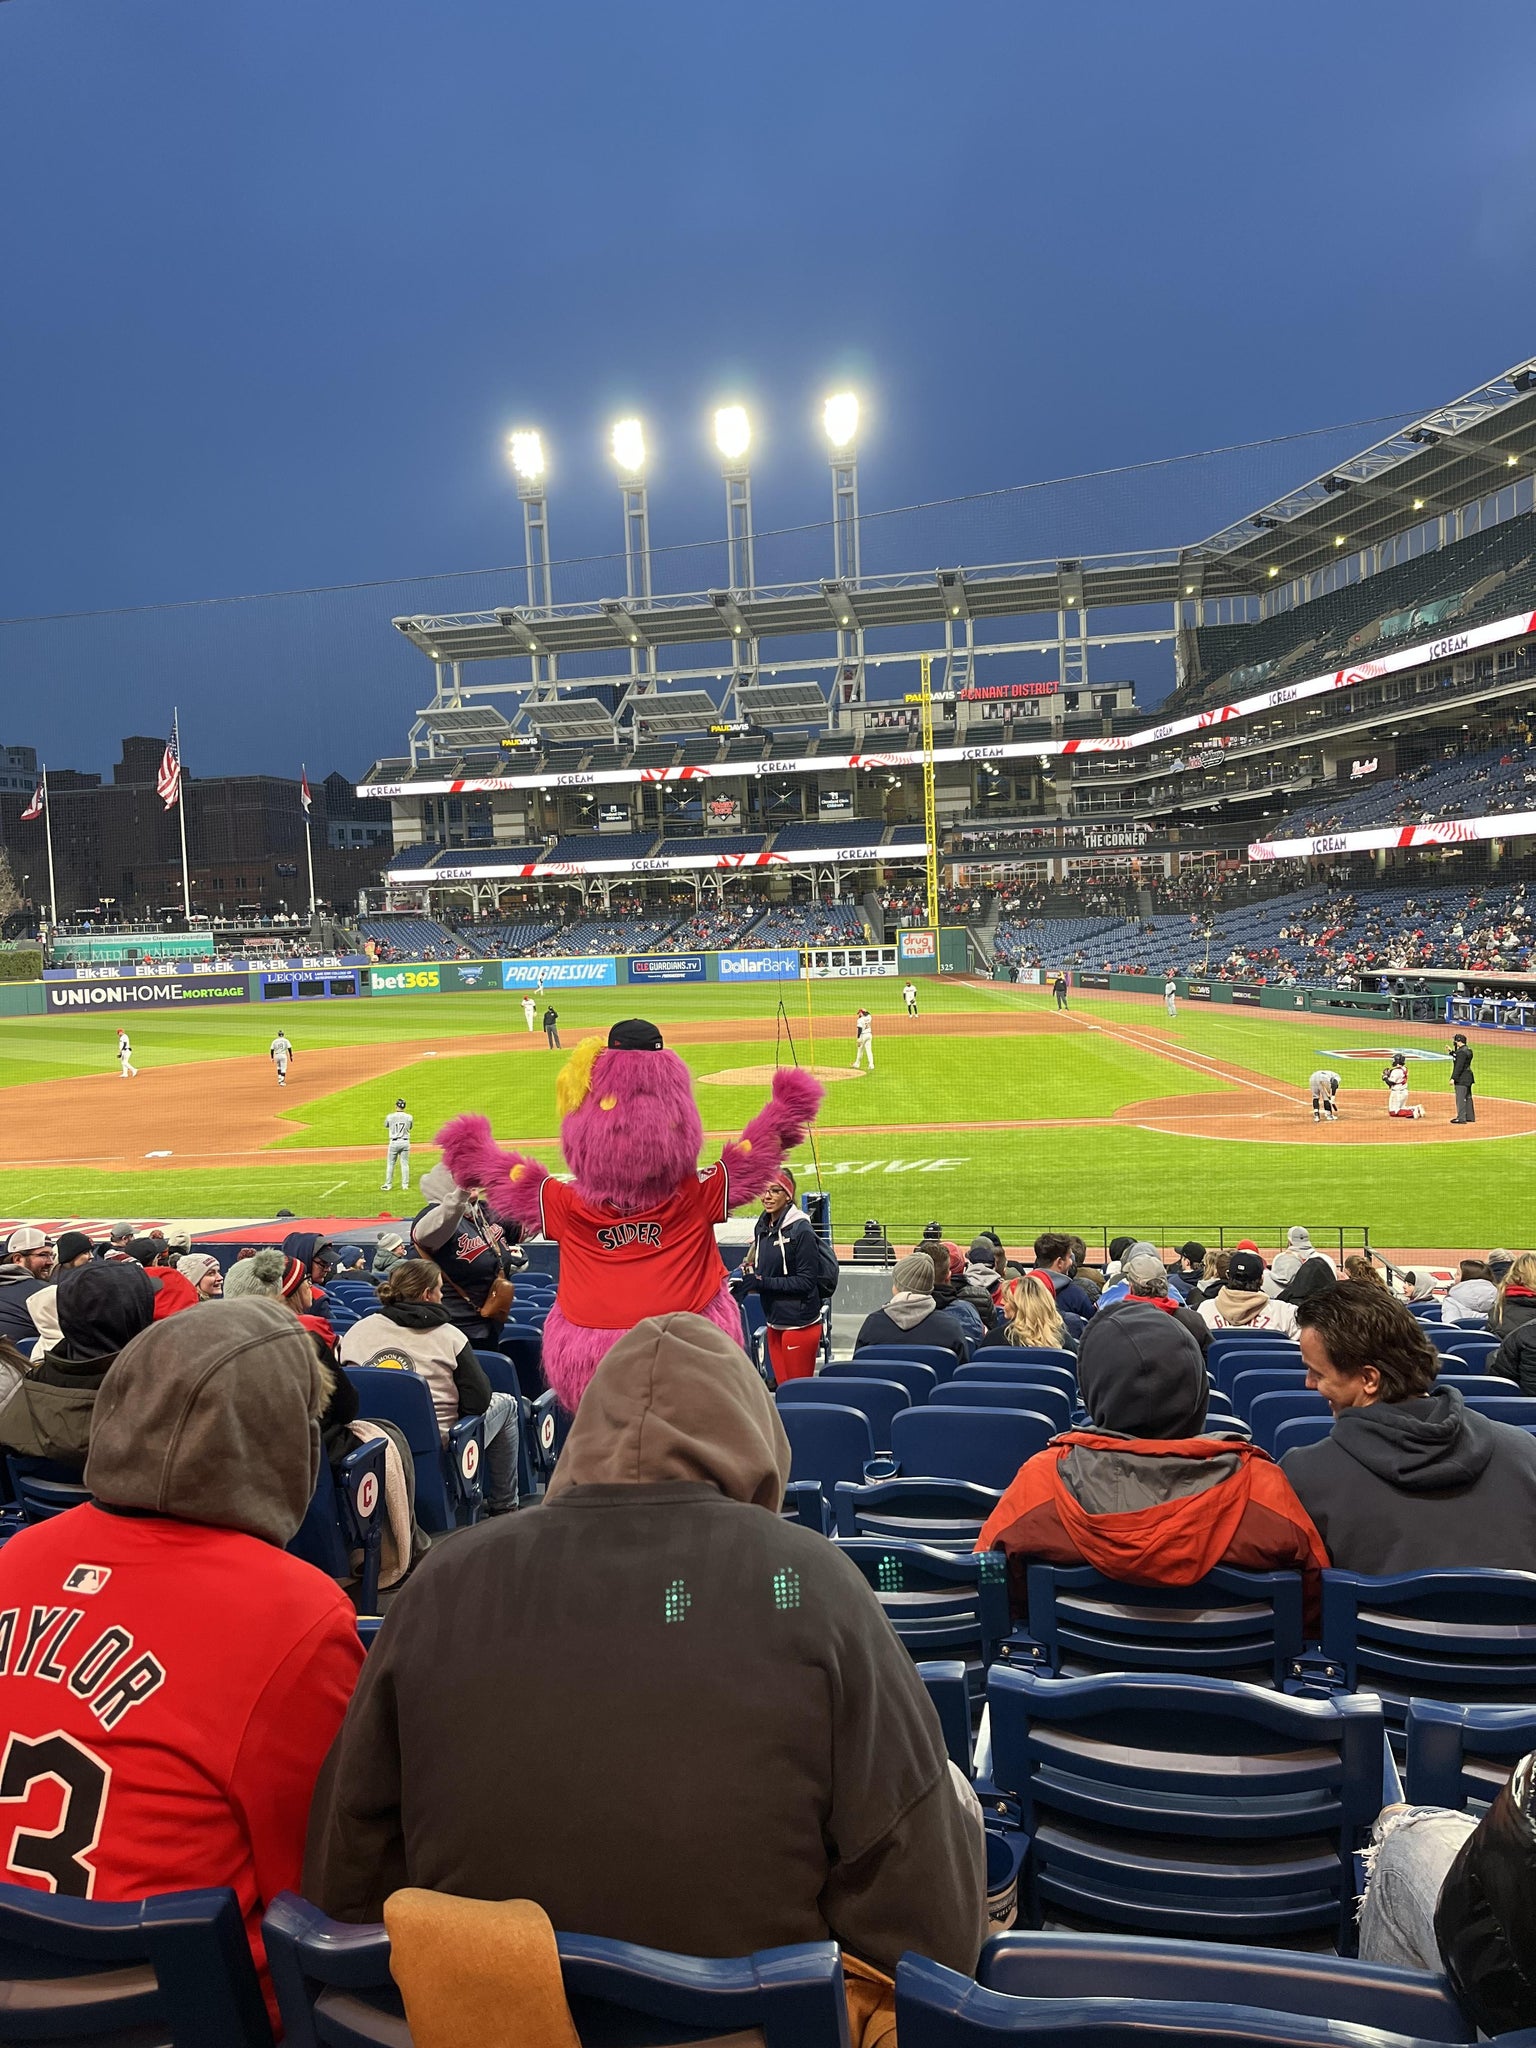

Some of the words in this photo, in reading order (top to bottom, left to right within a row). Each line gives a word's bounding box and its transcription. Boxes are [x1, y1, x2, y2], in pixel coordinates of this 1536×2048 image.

[1430, 635, 1468, 660] SCREAM
[1011, 681, 1060, 697] DISTRICT
[1269, 687, 1297, 706] SCREAM
[1153, 725, 1173, 741] SCREAM
[962, 747, 1004, 760] SCREAM
[756, 762, 796, 773] SCREAM
[557, 774, 594, 786] SCREAM
[366, 785, 401, 797] SCREAM
[1084, 834, 1103, 848] THE
[1104, 832, 1146, 846] CORNER
[1312, 837, 1346, 855] SCREAM
[837, 850, 877, 860] SCREAM
[631, 860, 670, 871] SCREAM
[436, 869, 472, 880] SCREAM
[903, 932, 929, 946] drug
[906, 946, 934, 955] mart
[505, 963, 609, 982] PROGRESSIVE
[839, 966, 886, 976] CLIFFS
[940, 963, 954, 971] 325
[372, 972, 439, 989] bet365
[183, 987, 244, 999] MORTGAGE
[395, 1122, 406, 1134] 17
[597, 1222, 662, 1250] SLIDER
[465, 1448, 475, 1470] C
[363, 1479, 373, 1507] C
